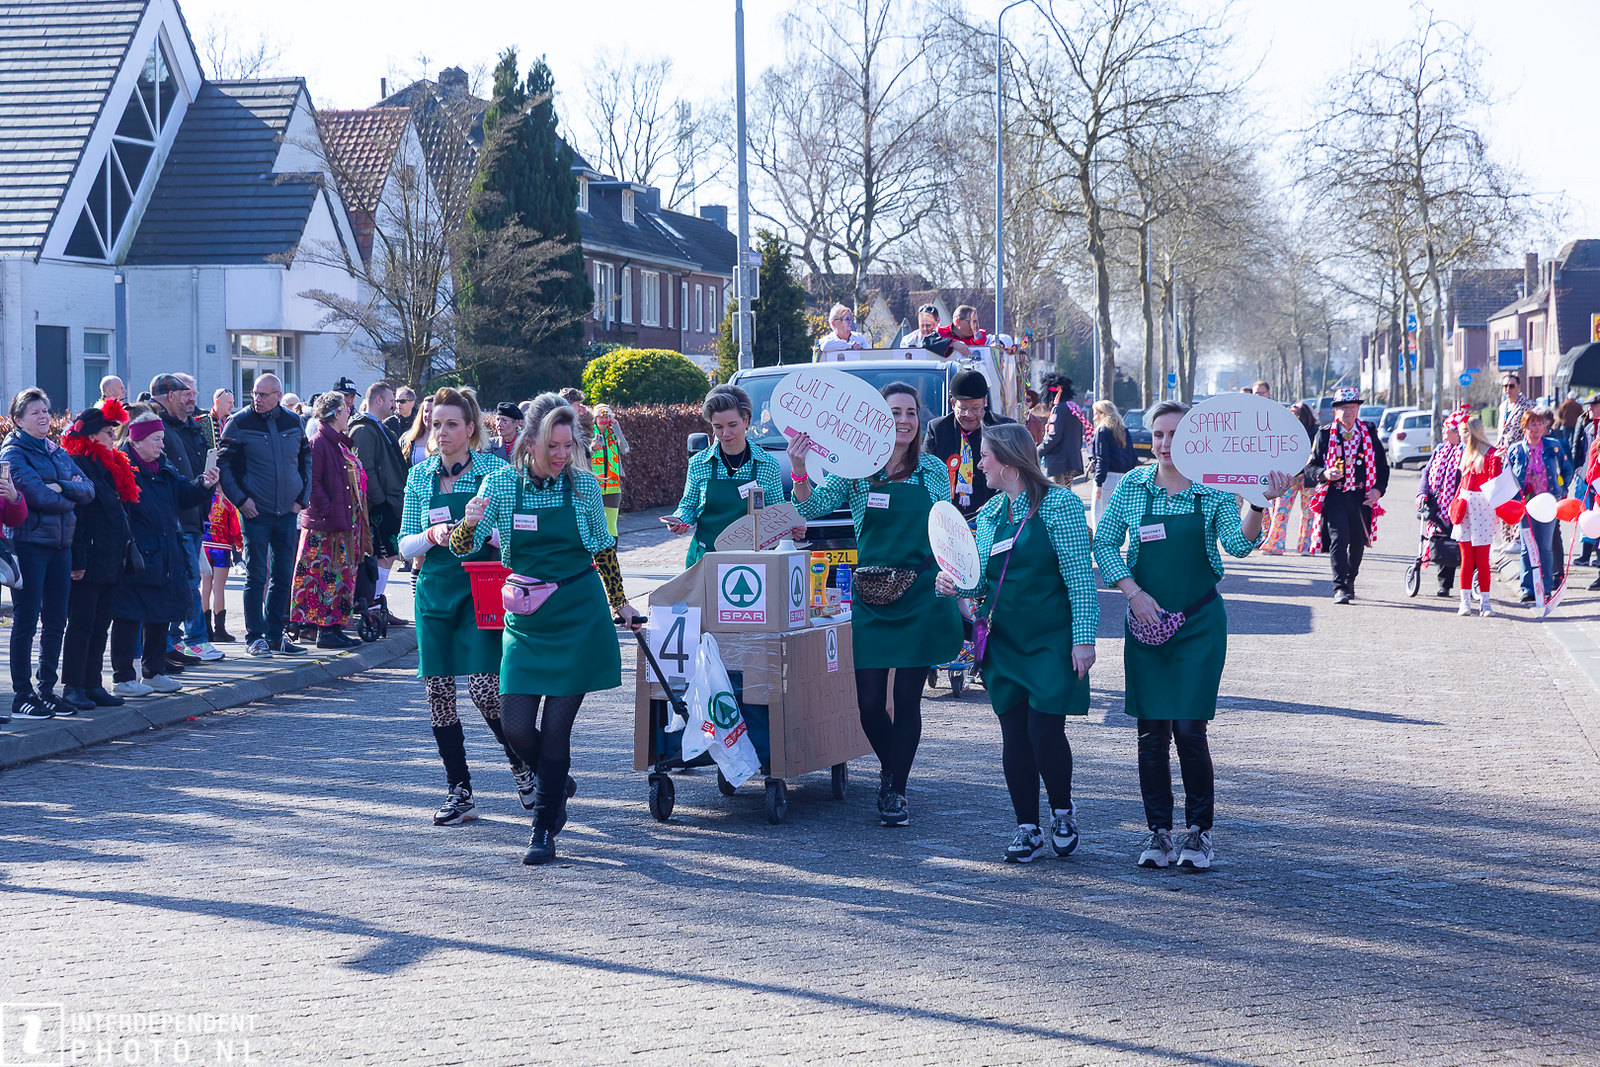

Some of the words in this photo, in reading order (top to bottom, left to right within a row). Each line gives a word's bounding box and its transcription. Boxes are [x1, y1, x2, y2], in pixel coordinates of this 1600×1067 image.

[779, 392, 813, 419] GELD
[816, 411, 877, 455] OPNEMEN
[836, 391, 851, 413] U
[853, 402, 894, 438] EXTRA
[1189, 411, 1242, 433] SPAART
[1256, 411, 1272, 432] U
[1217, 475, 1258, 484] SPAR
[763, 512, 793, 534] CENT
[722, 611, 763, 620] SPAR
[659, 616, 689, 674] 4
